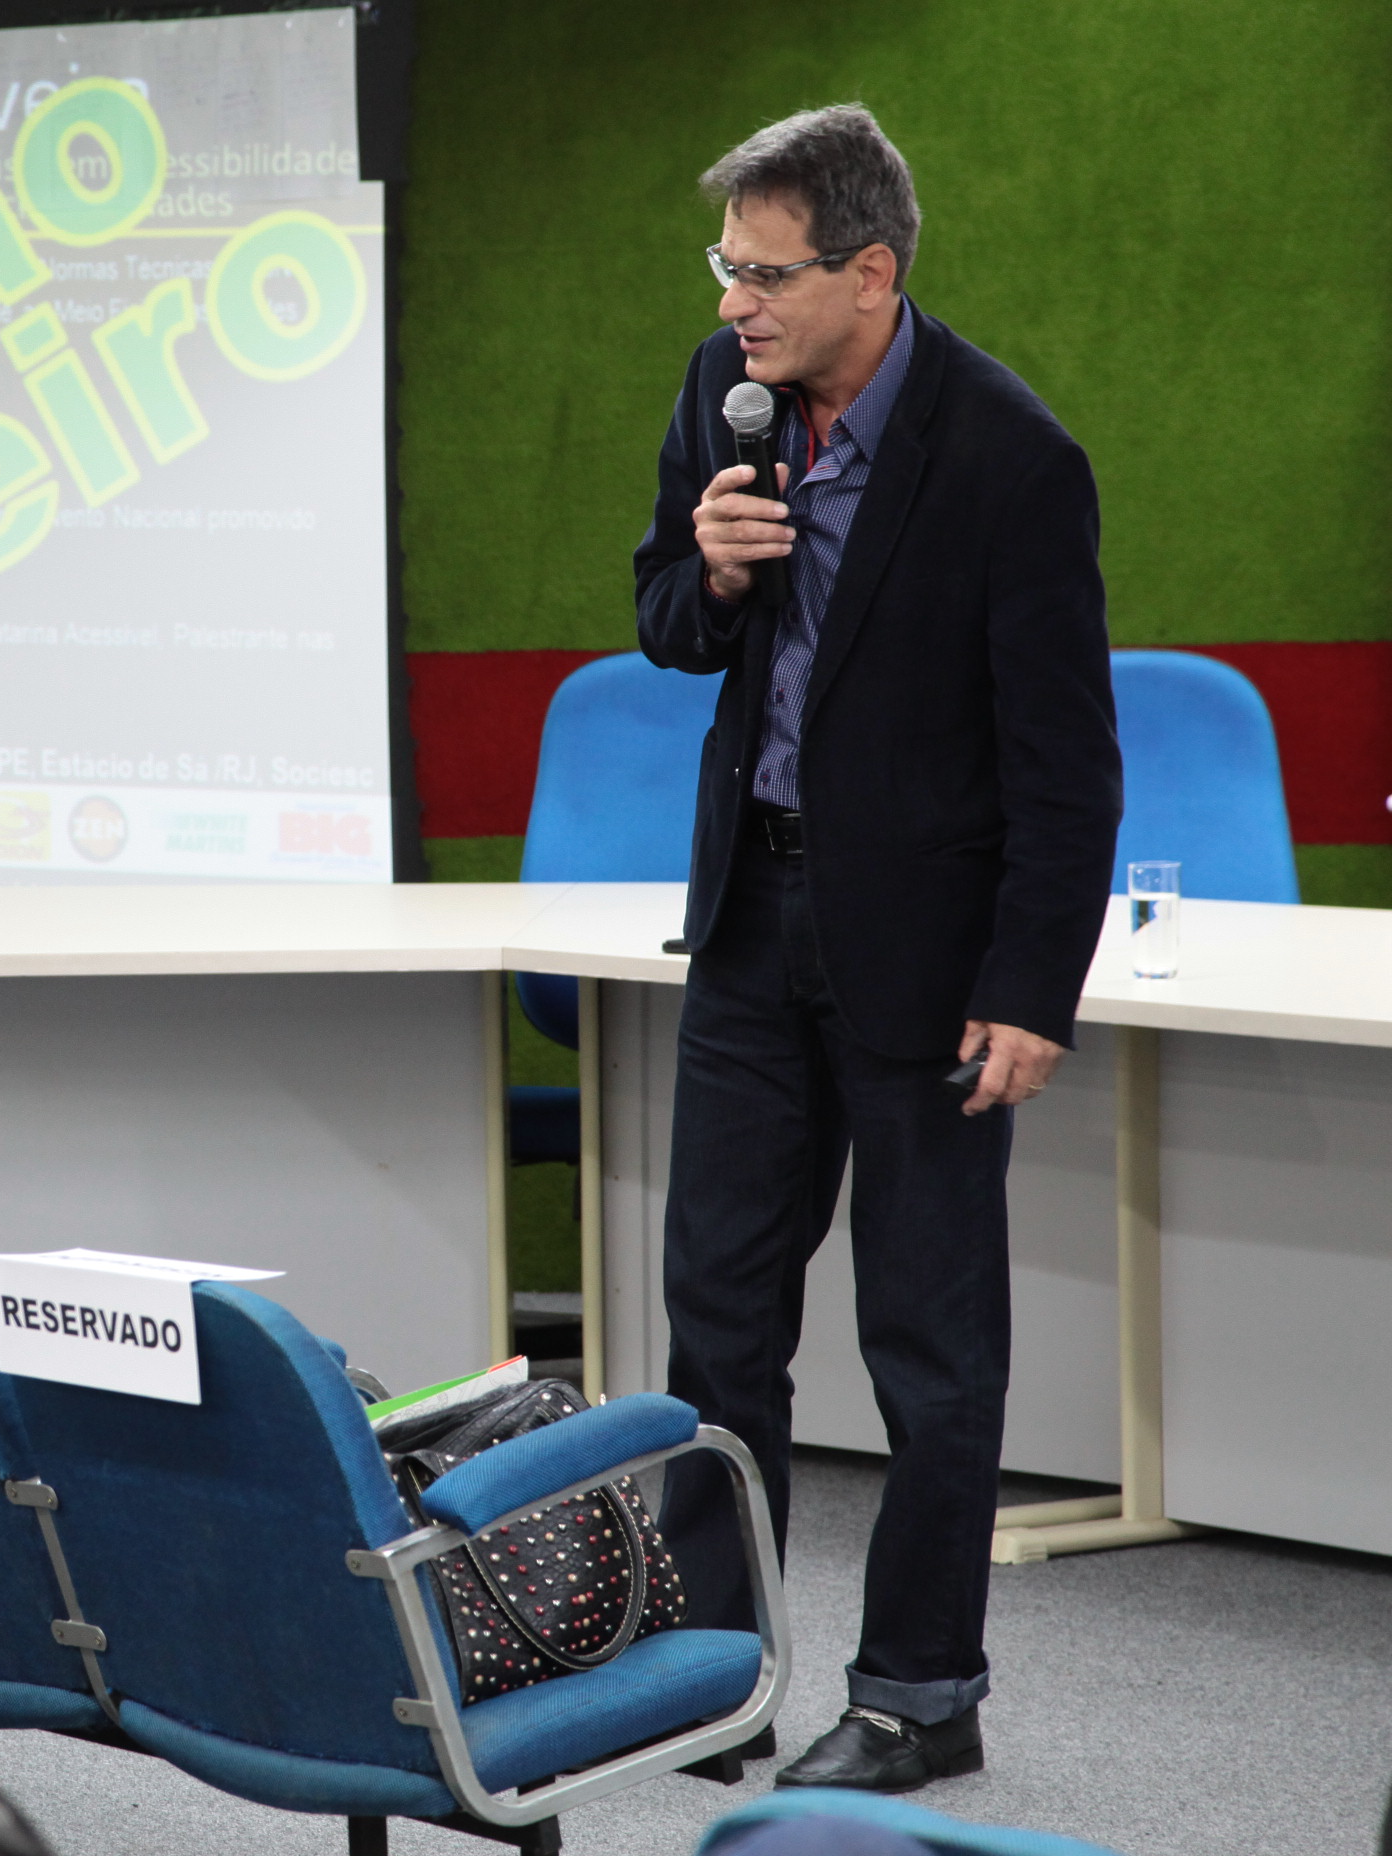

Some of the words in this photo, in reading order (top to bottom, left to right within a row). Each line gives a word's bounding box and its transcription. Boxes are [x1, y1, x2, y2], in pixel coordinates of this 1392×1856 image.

[112, 504, 202, 529] Nacional
[207, 505, 316, 536] promovido
[138, 753, 170, 780] de
[72, 817, 125, 840] ZEN
[1, 1295, 182, 1353] RESERVADO
